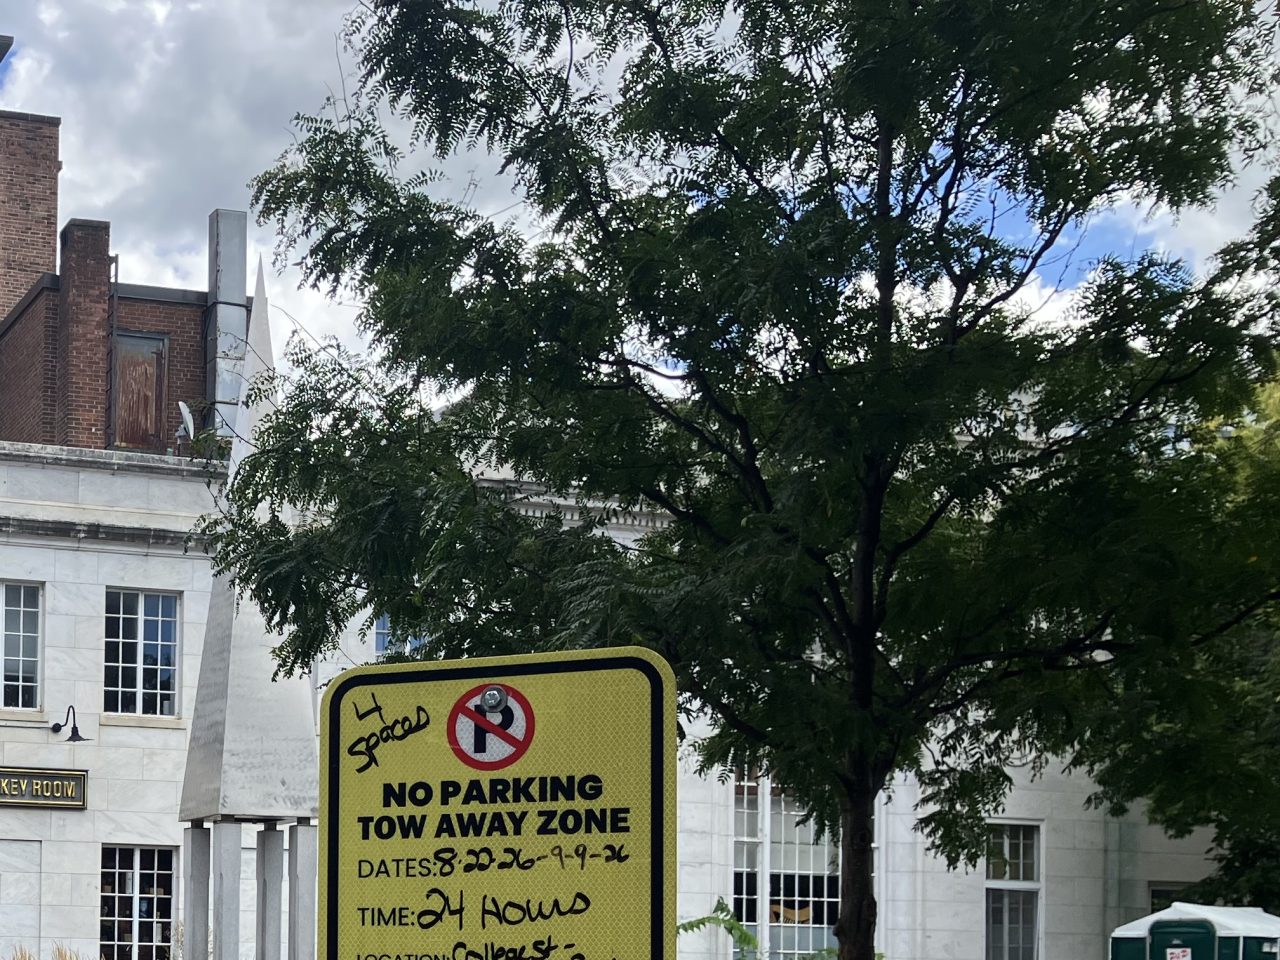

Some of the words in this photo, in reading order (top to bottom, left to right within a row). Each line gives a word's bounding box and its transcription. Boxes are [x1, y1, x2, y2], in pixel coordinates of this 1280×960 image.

[352, 692, 386, 725] 4
[32, 779, 76, 798] ROOM
[382, 781, 433, 808] NO
[440, 774, 603, 806] PARKING
[357, 814, 427, 840] TOW
[434, 811, 530, 838] AWAY
[537, 807, 631, 836] ZONE
[357, 858, 437, 878] DATES:
[357, 907, 415, 927] TIME:
[417, 888, 464, 930] 24
